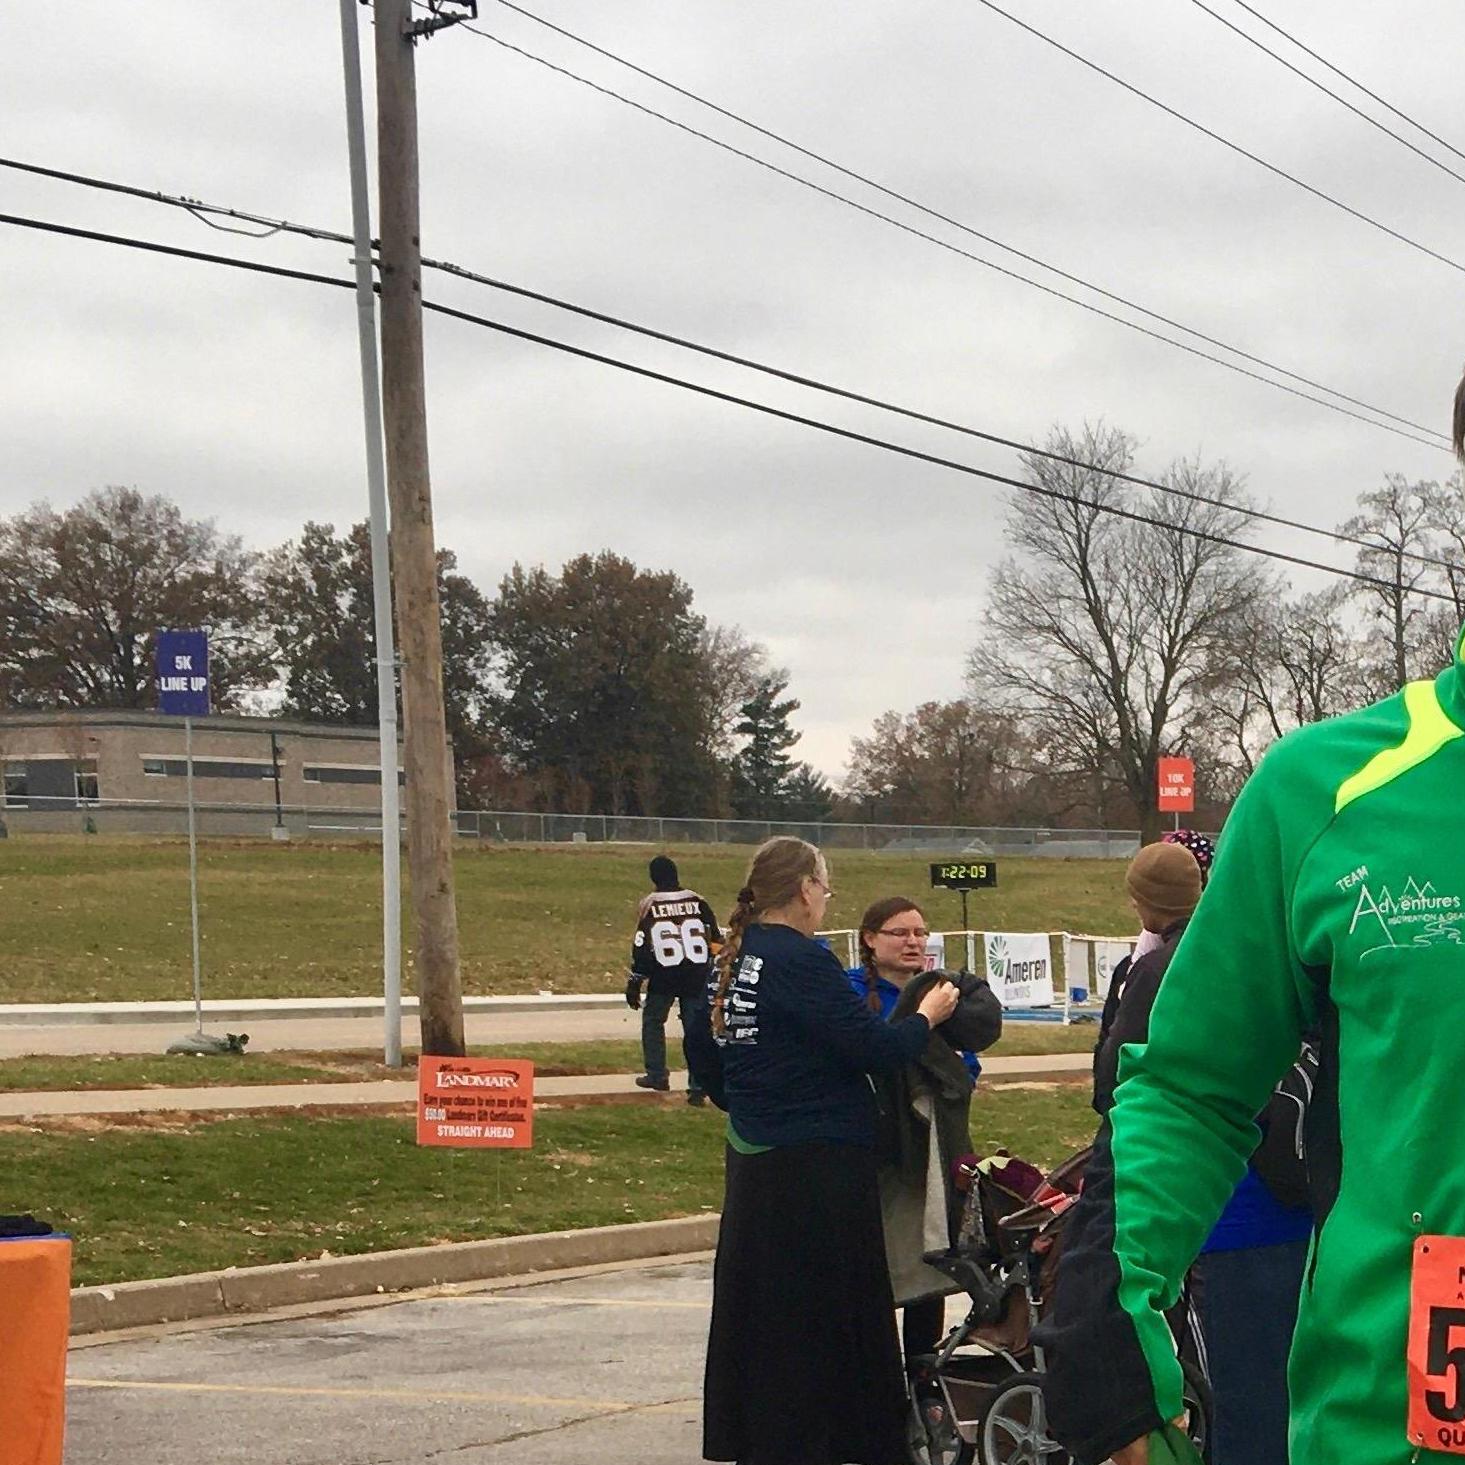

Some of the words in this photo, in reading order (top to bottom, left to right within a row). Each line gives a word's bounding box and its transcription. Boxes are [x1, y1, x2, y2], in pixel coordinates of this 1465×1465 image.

[174, 655, 192, 670] 5K
[160, 677, 188, 691] LINE
[190, 677, 207, 692] UP
[1167, 773, 1184, 784] 10K
[1160, 786, 1178, 797] LINE
[1335, 865, 1369, 893] TEAM
[651, 901, 701, 918] LEMIEUX
[651, 918, 708, 967] 66
[1004, 958, 1047, 985] Ameren
[437, 1125, 482, 1137] STRAIGHT
[484, 1127, 515, 1139] AHEAD
[1457, 1291, 1464, 1301] A
